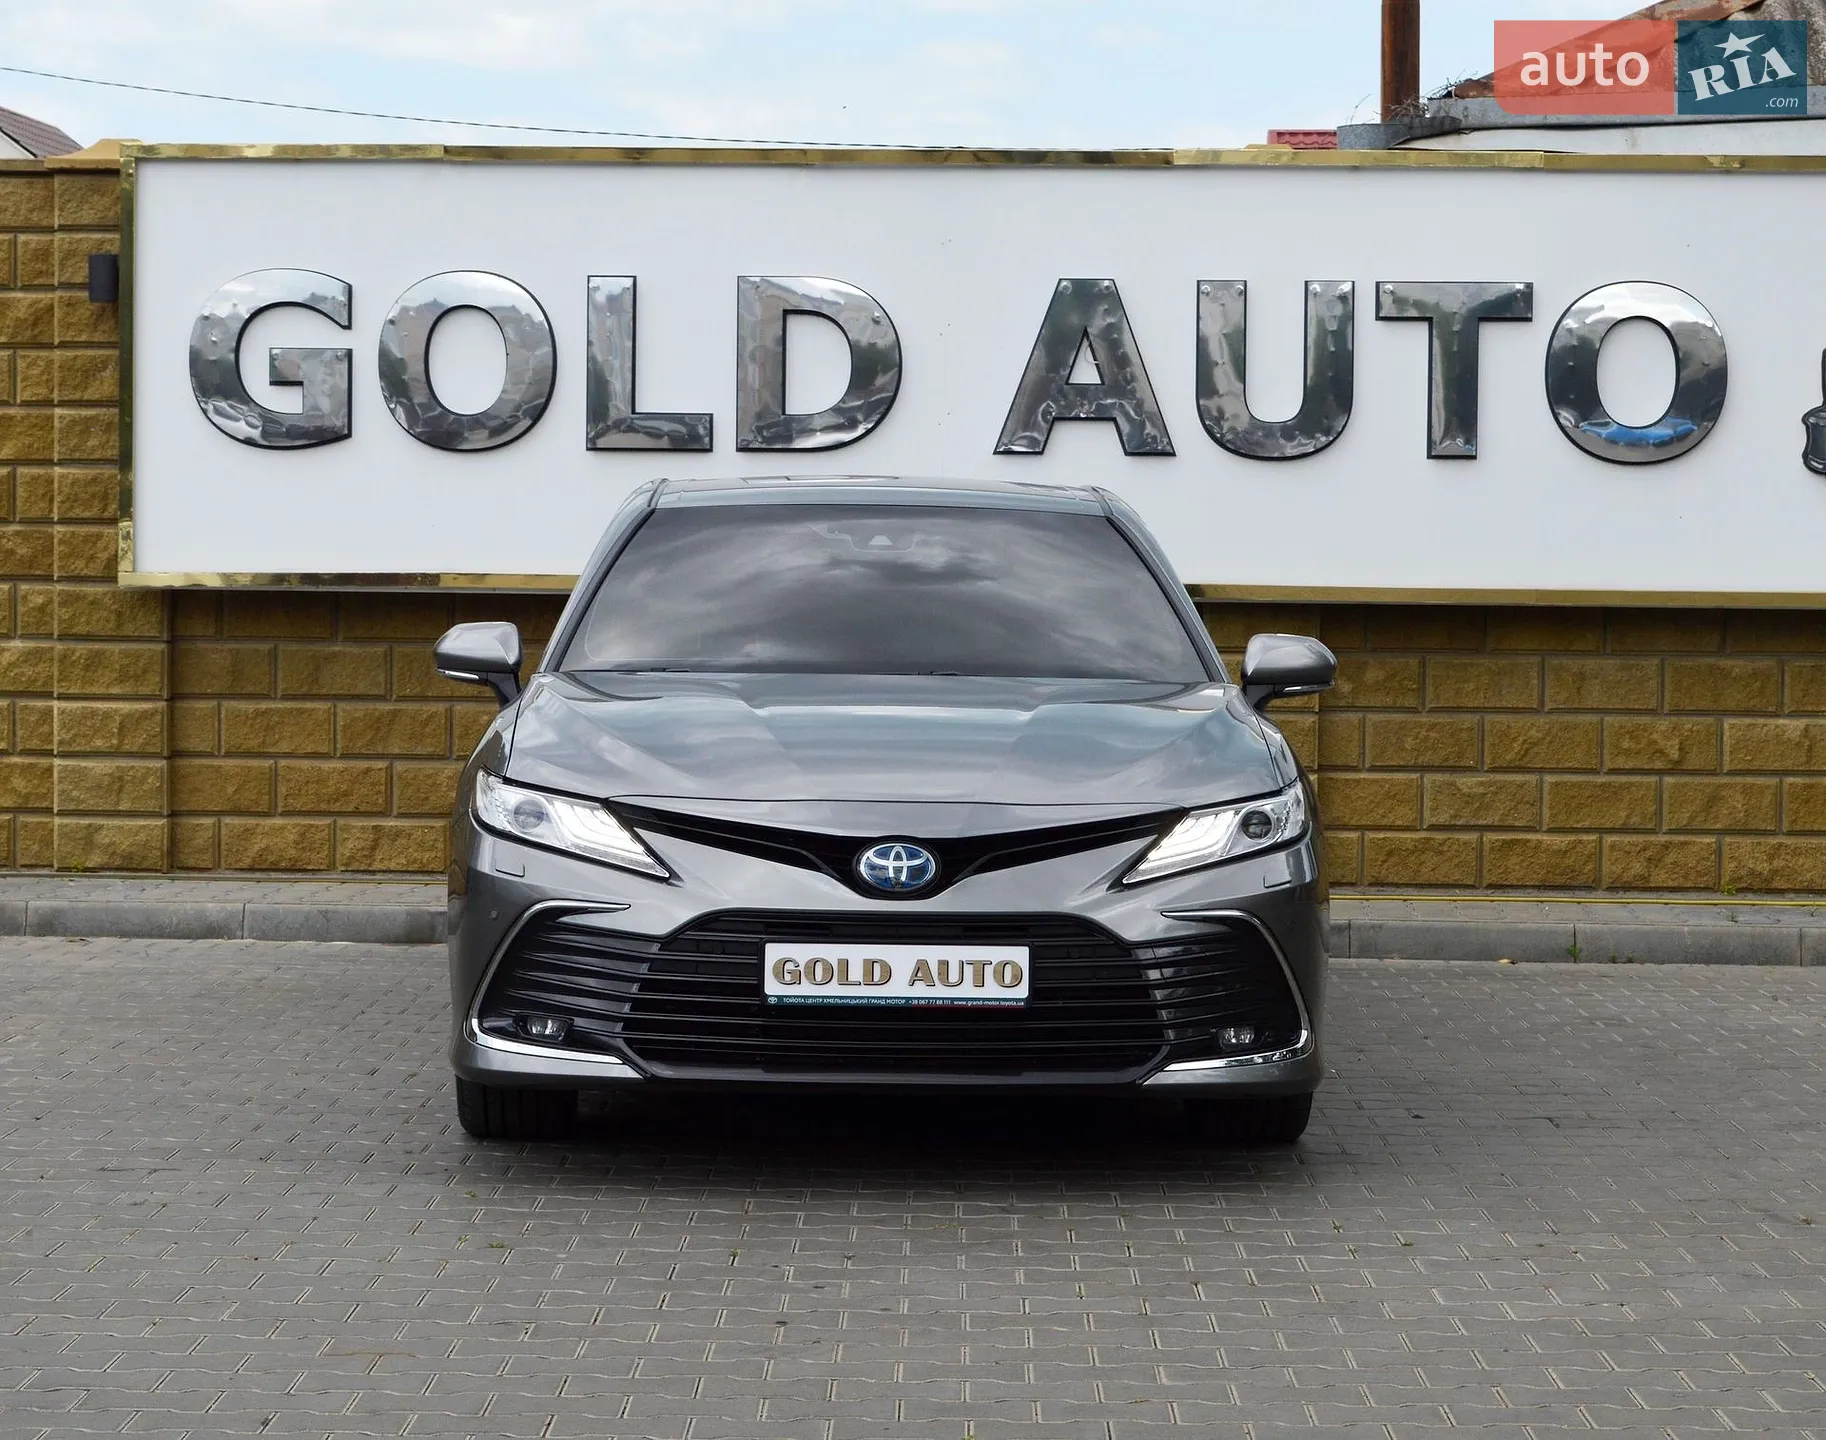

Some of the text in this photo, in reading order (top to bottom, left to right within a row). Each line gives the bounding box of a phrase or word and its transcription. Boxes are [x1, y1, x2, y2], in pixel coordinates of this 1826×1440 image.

[189, 268, 1728, 465] GOLD AUTO
[772, 956, 1023, 988] GOLD AUTO
